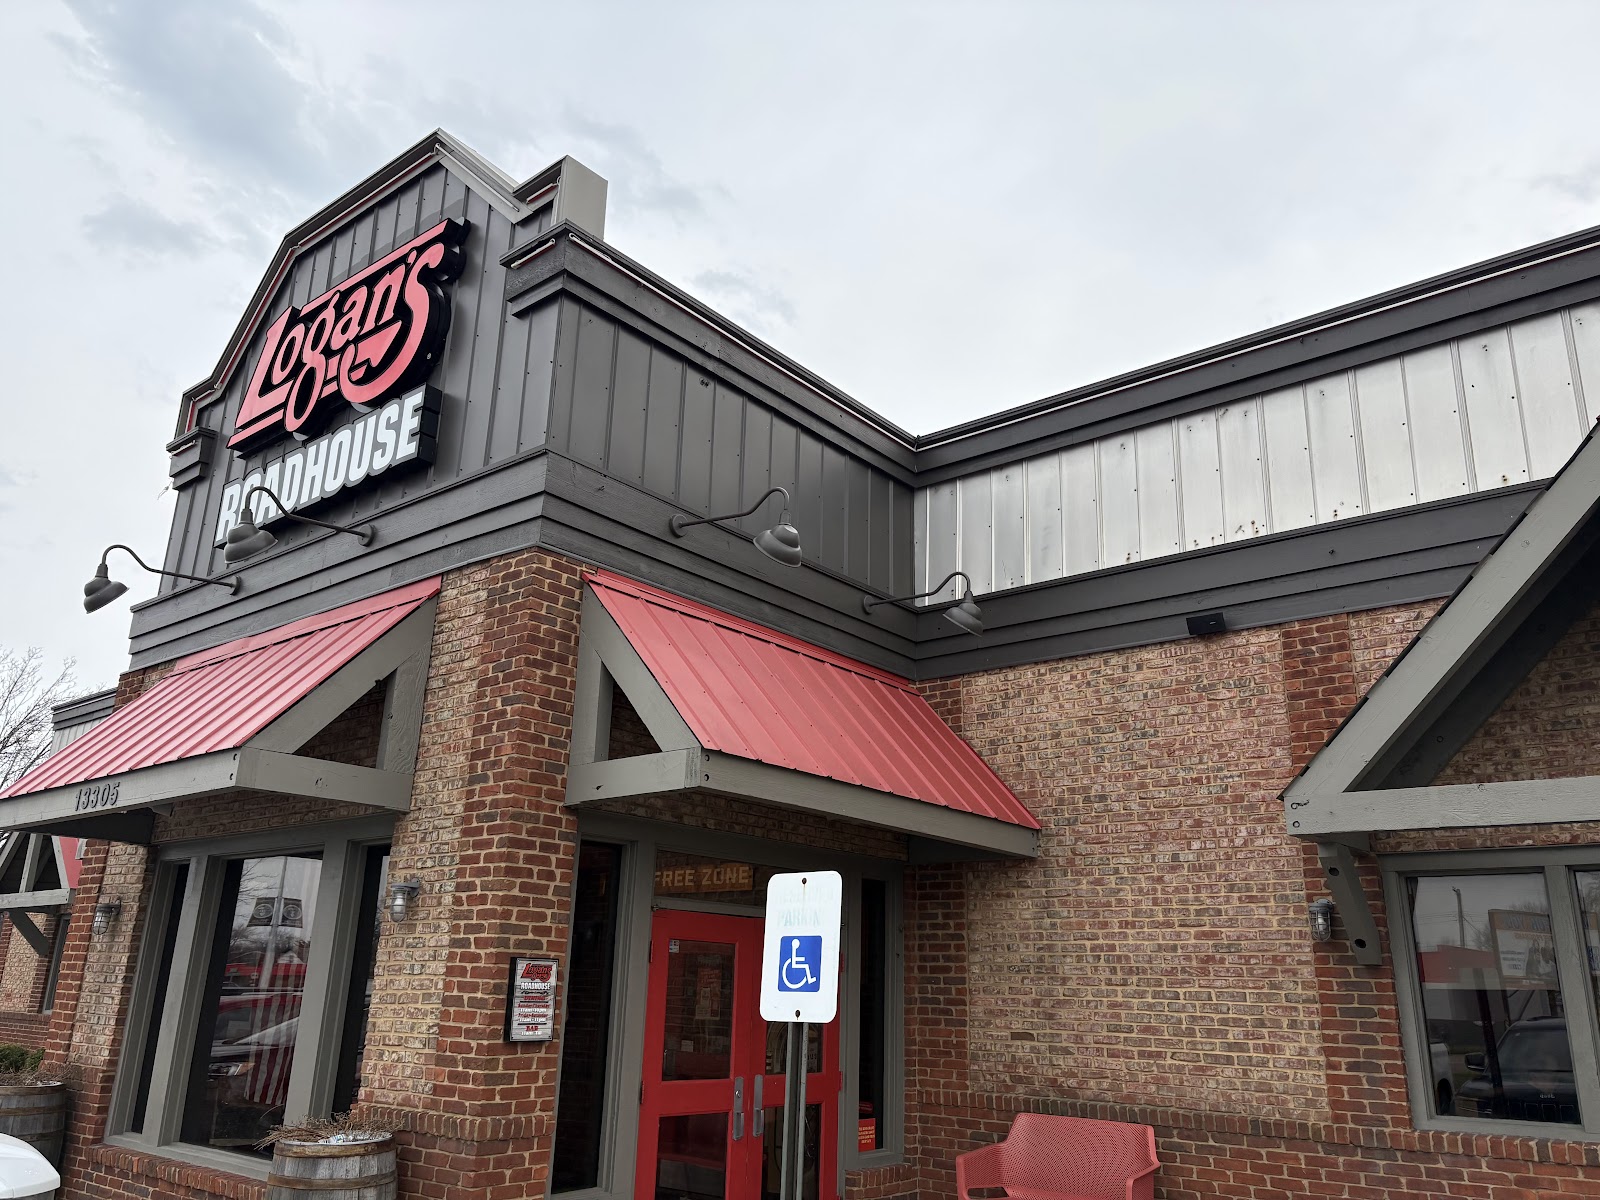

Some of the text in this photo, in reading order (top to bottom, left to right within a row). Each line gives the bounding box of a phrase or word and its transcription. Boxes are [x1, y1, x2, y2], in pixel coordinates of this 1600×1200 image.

[216, 391, 423, 542] ROADHOUSE
[74, 781, 121, 812] 13305
[701, 866, 750, 885] ZONE
[520, 982, 551, 990] ROADHOUSE
